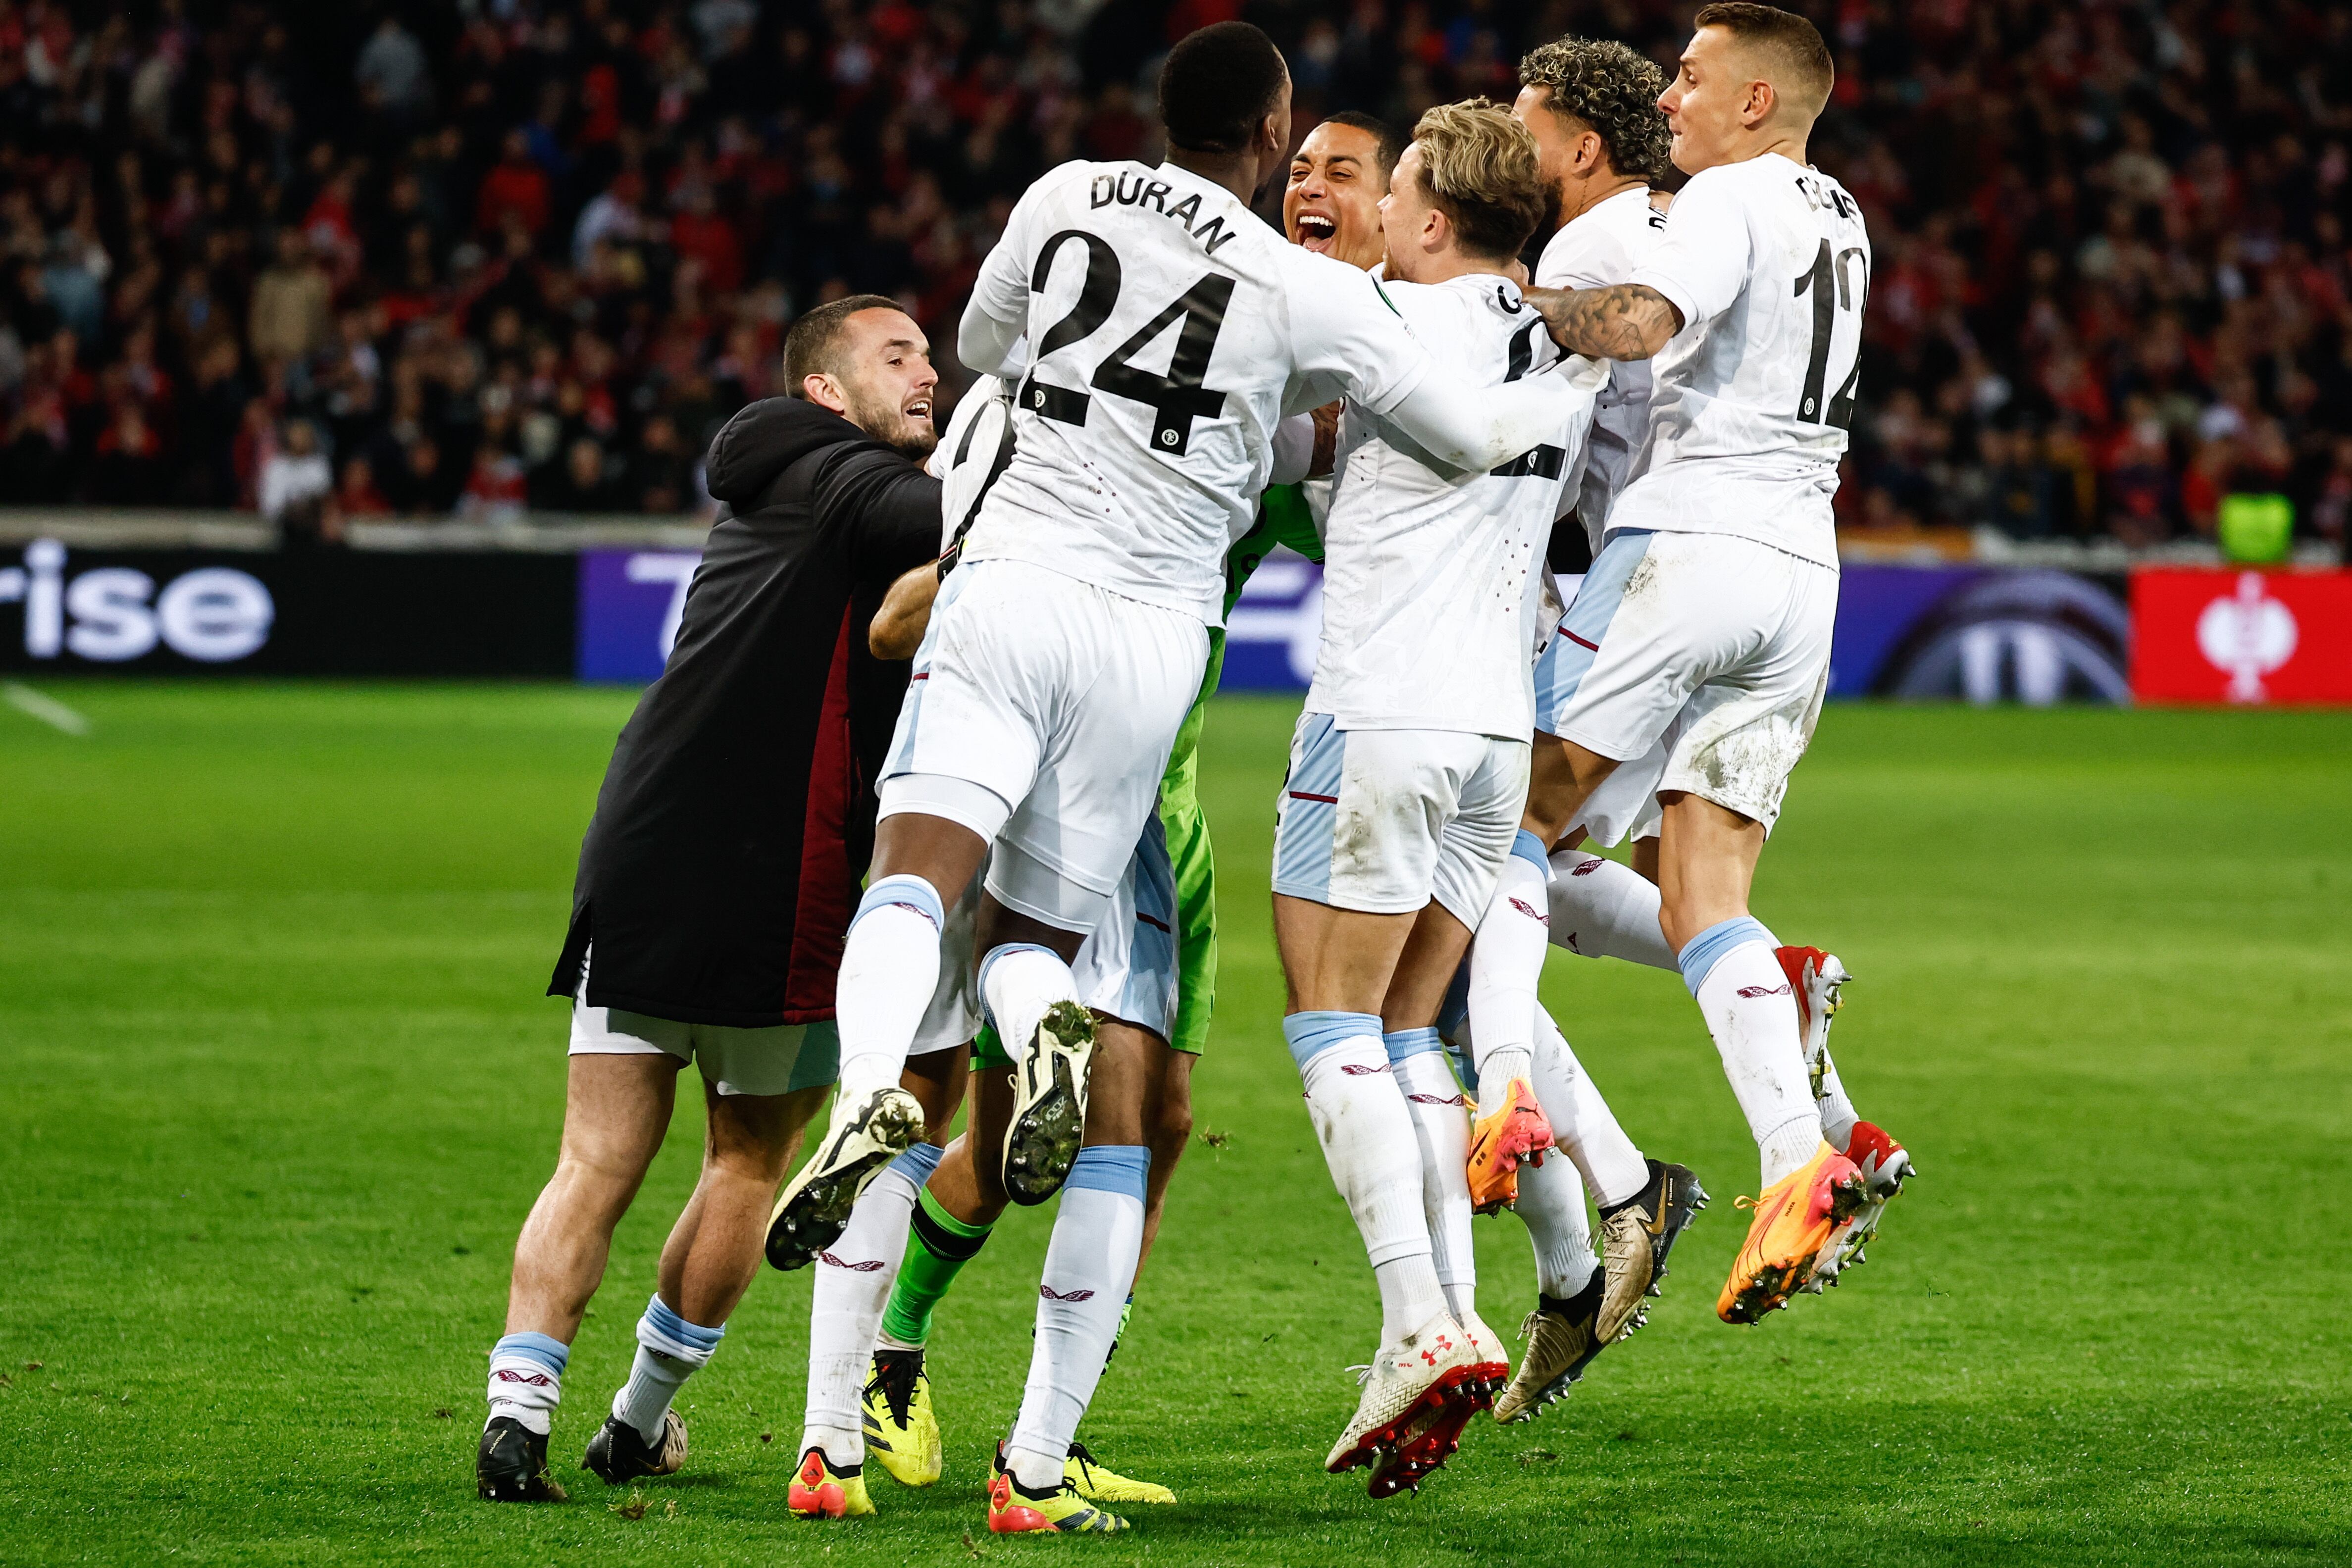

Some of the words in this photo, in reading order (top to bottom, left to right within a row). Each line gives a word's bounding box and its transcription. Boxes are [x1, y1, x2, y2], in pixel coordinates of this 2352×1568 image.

[1091, 171, 1236, 255] DURAN
[1020, 229, 1236, 456] 24
[1794, 238, 1867, 430] 12
